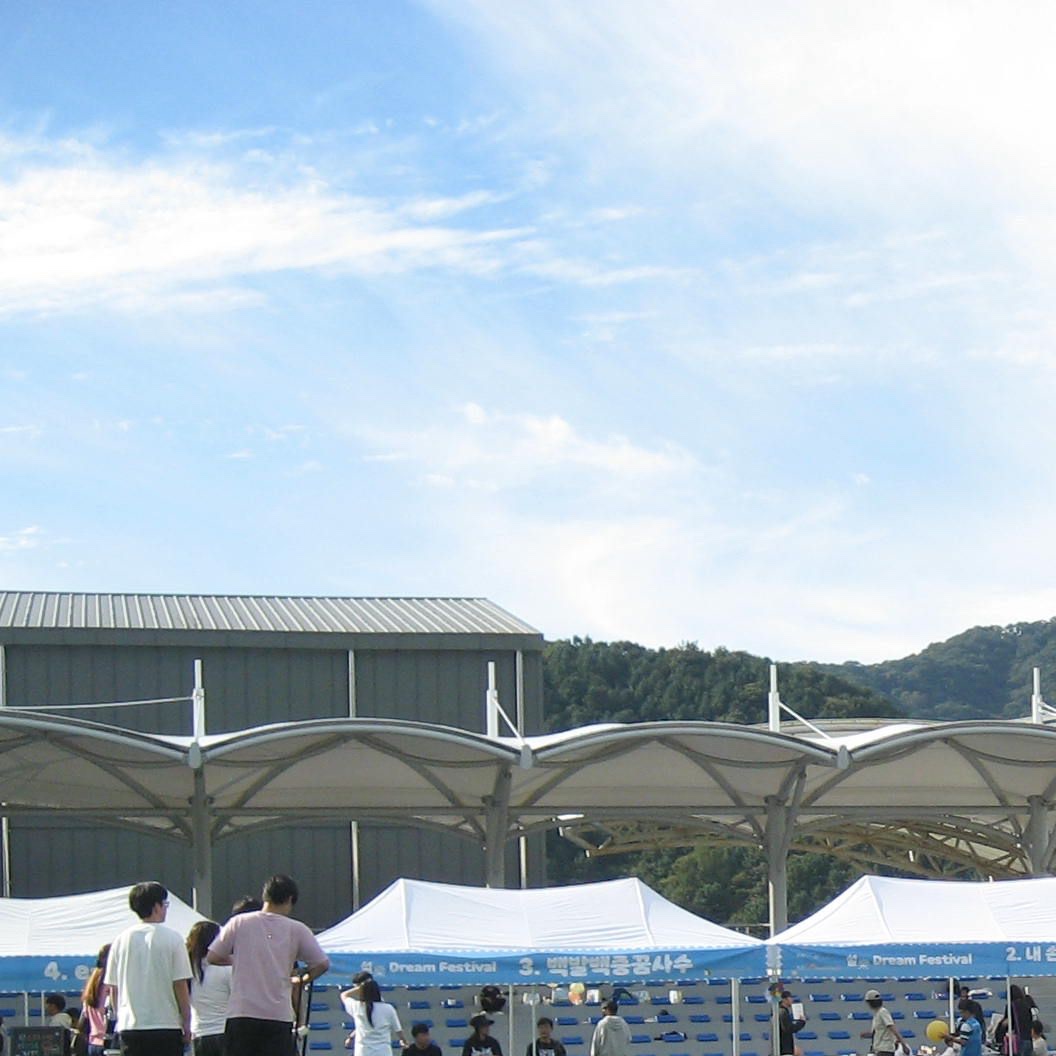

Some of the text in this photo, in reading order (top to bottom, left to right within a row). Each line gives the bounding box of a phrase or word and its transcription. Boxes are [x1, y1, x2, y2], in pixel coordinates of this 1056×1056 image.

[872, 955, 916, 966] Dream
[919, 953, 973, 966] Festival
[1006, 946, 1021, 961] 2.
[1025, 946, 1041, 962] 내
[44, 961, 68, 980] 4.
[389, 962, 436, 973] Dream
[439, 961, 497, 973] Festival
[519, 957, 540, 976] 3.
